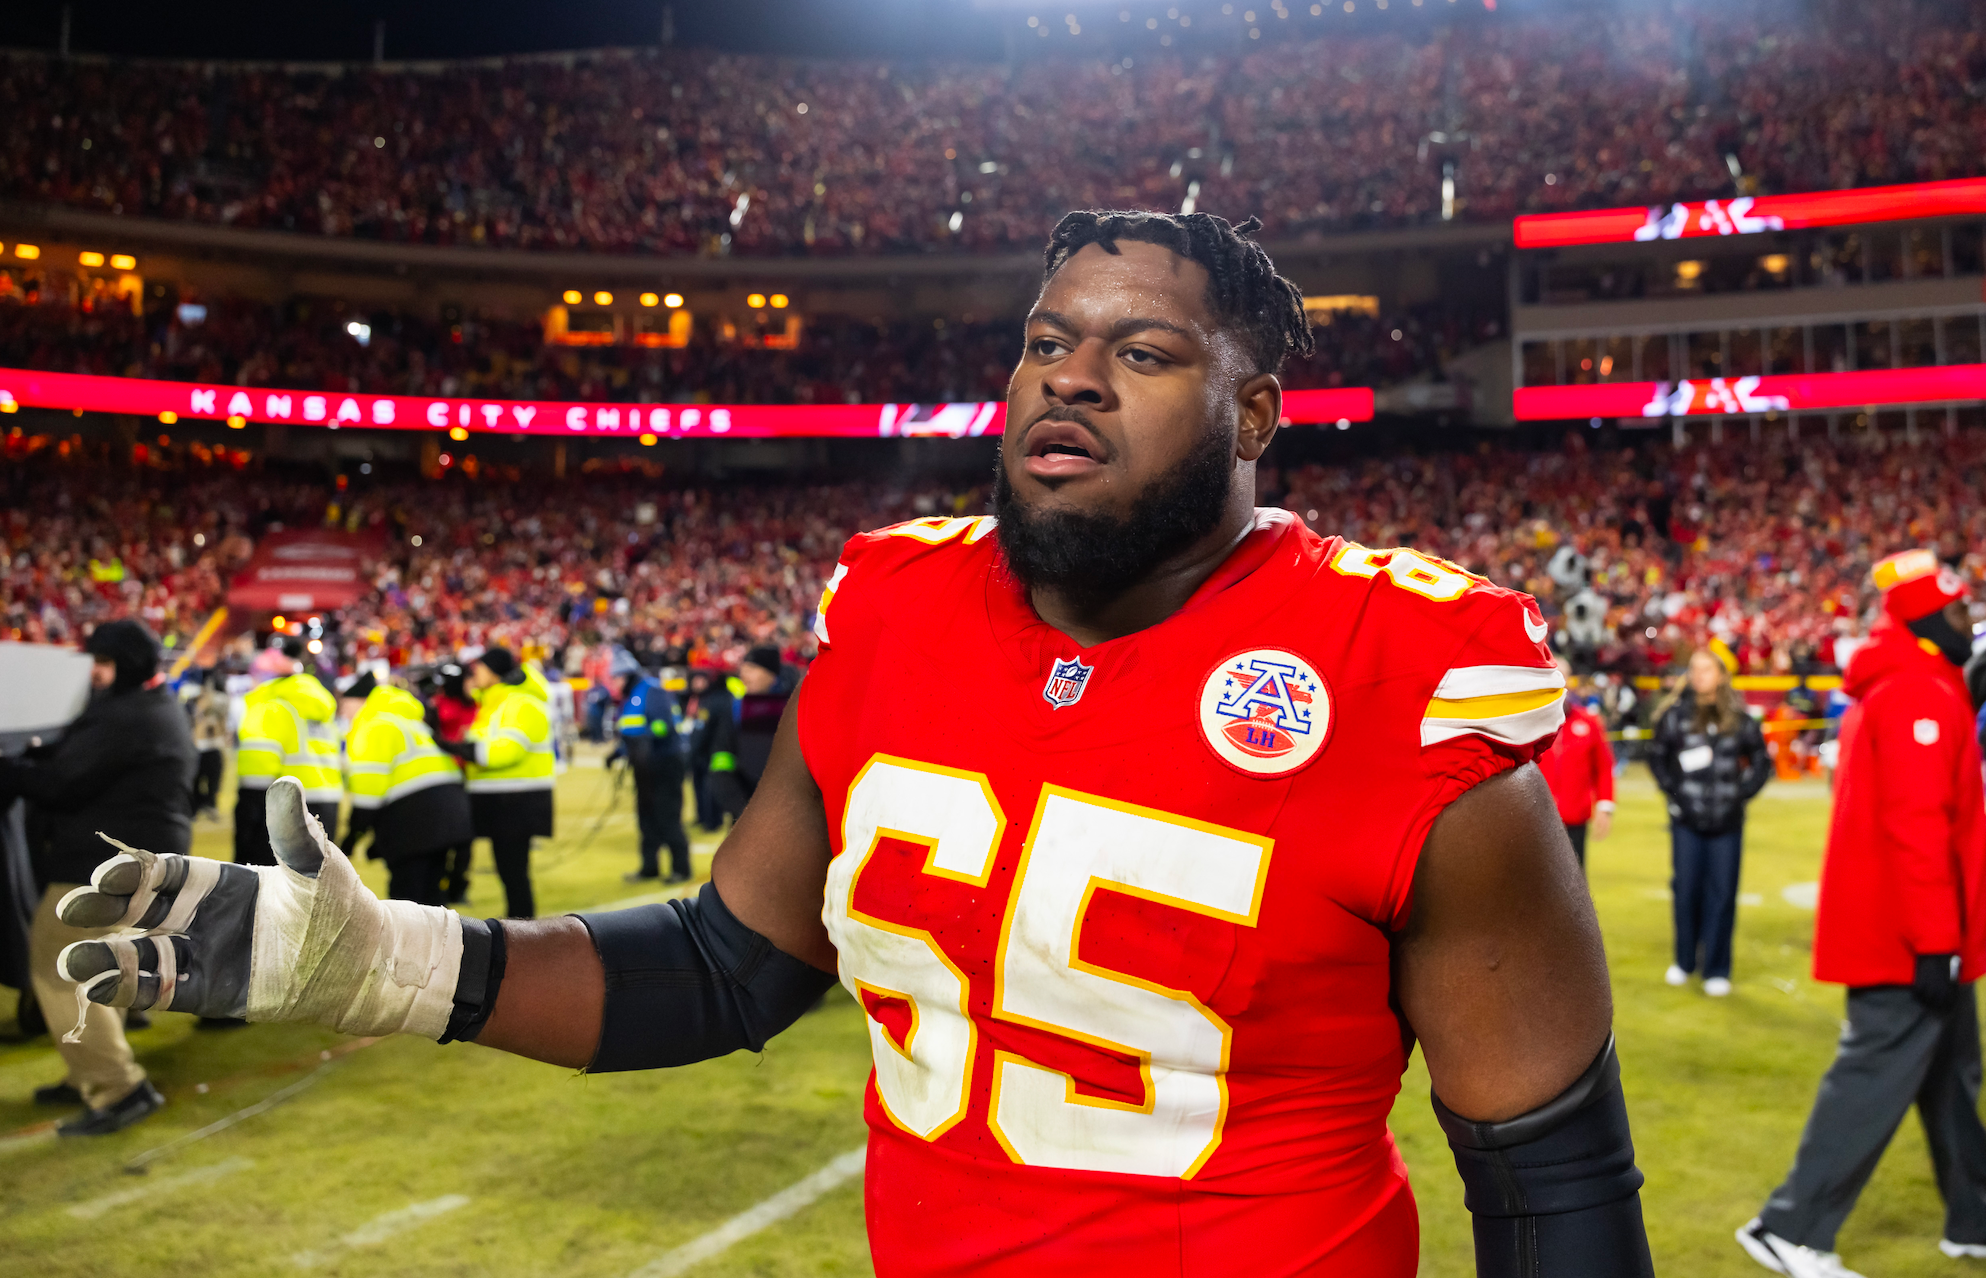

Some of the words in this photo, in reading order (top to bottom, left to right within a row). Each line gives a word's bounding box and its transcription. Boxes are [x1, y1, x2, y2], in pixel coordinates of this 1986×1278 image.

[191, 389, 396, 424] KANSAS
[427, 402, 537, 429] CITY
[566, 406, 731, 433] CHIEFS
[1049, 678, 1077, 700] NFL
[1245, 726, 1276, 749] LH
[821, 752, 1275, 1180] 65
